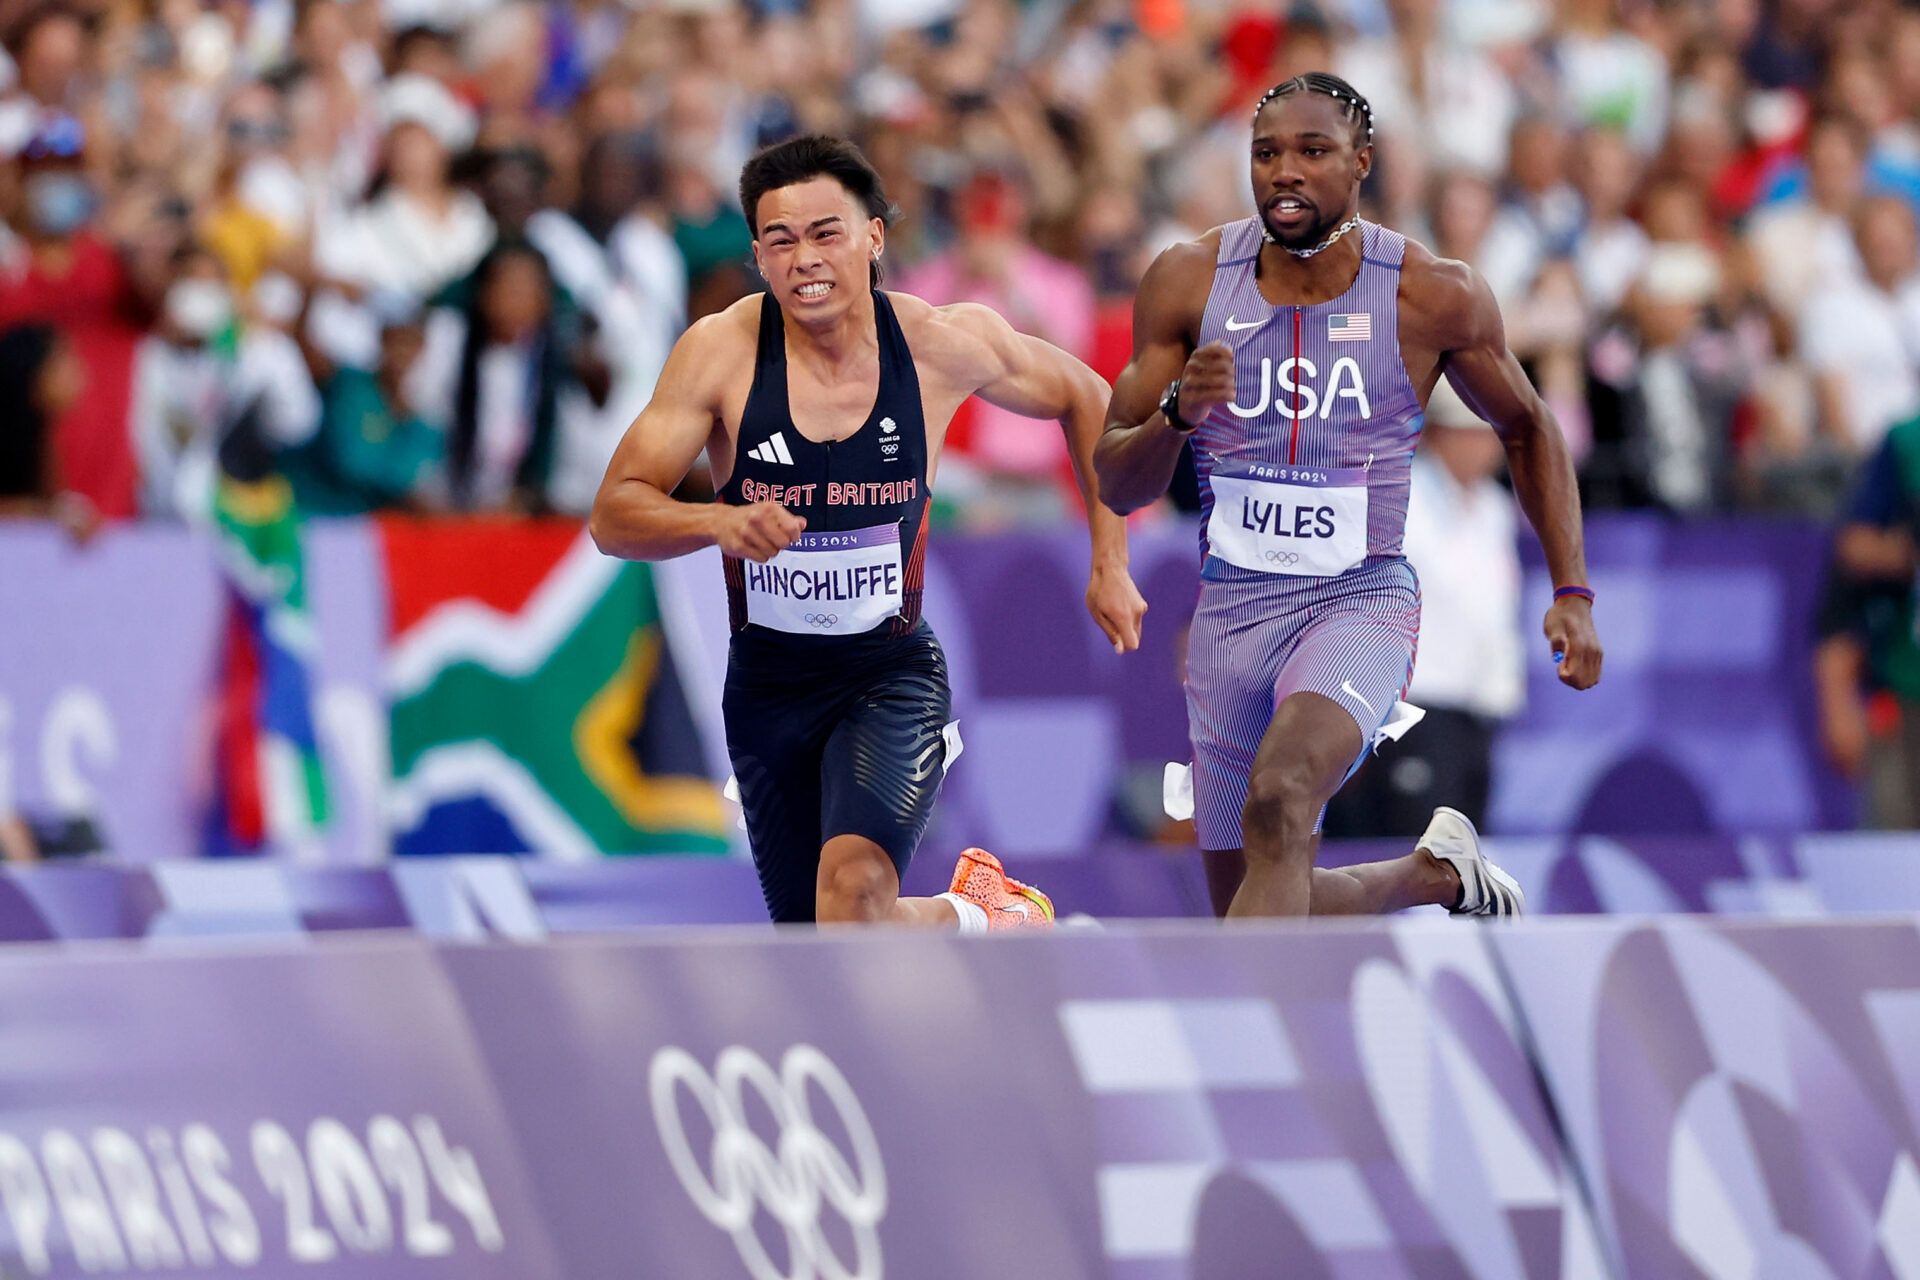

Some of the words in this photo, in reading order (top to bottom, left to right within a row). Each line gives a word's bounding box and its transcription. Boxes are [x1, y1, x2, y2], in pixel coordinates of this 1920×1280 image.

[878, 436, 892, 444] TEAM
[1292, 470, 1327, 483] 2024
[742, 478, 817, 507] GREAT
[827, 478, 917, 506] BRITAIN
[1242, 495, 1335, 539] LYLES
[789, 537, 817, 548] RIS
[821, 535, 858, 547] 2024
[750, 562, 898, 602] HINCHLIFFE
[249, 1112, 506, 1264] 2024
